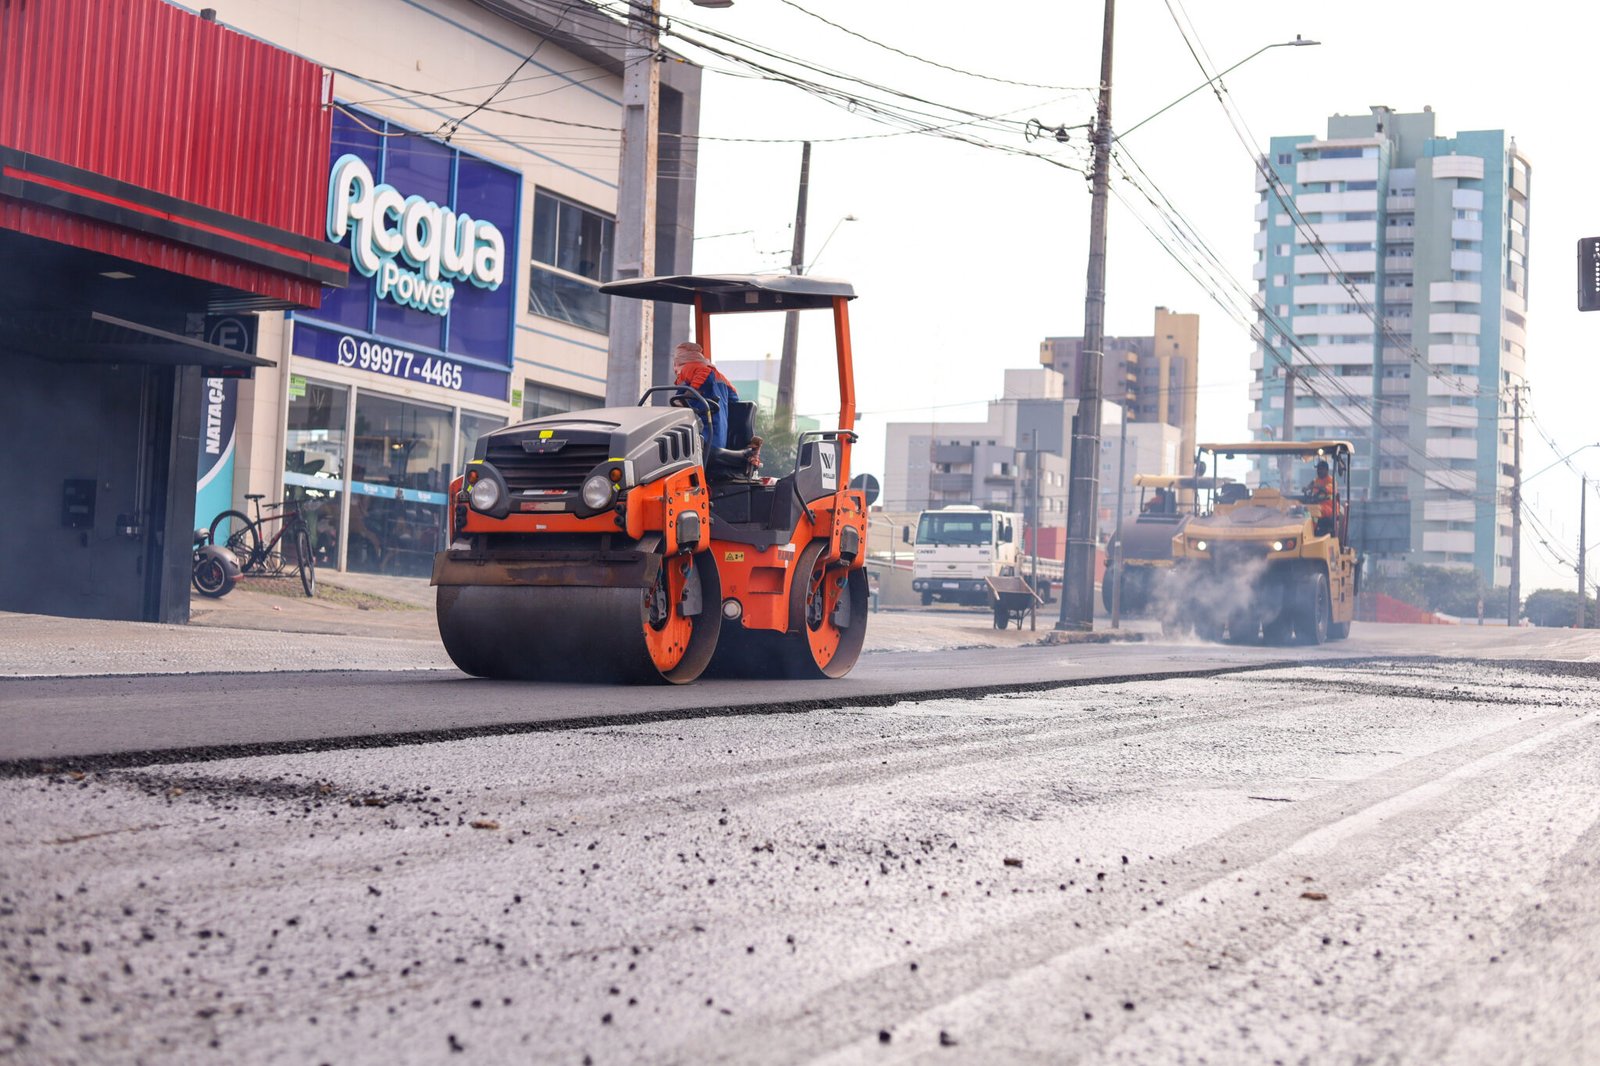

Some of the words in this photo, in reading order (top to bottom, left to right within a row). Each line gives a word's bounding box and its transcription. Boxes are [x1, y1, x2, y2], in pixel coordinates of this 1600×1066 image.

[328, 155, 505, 289] Acqua
[377, 262, 455, 314] Power
[359, 341, 463, 390] 99977-4465
[205, 377, 225, 455] NATAÇÃ
